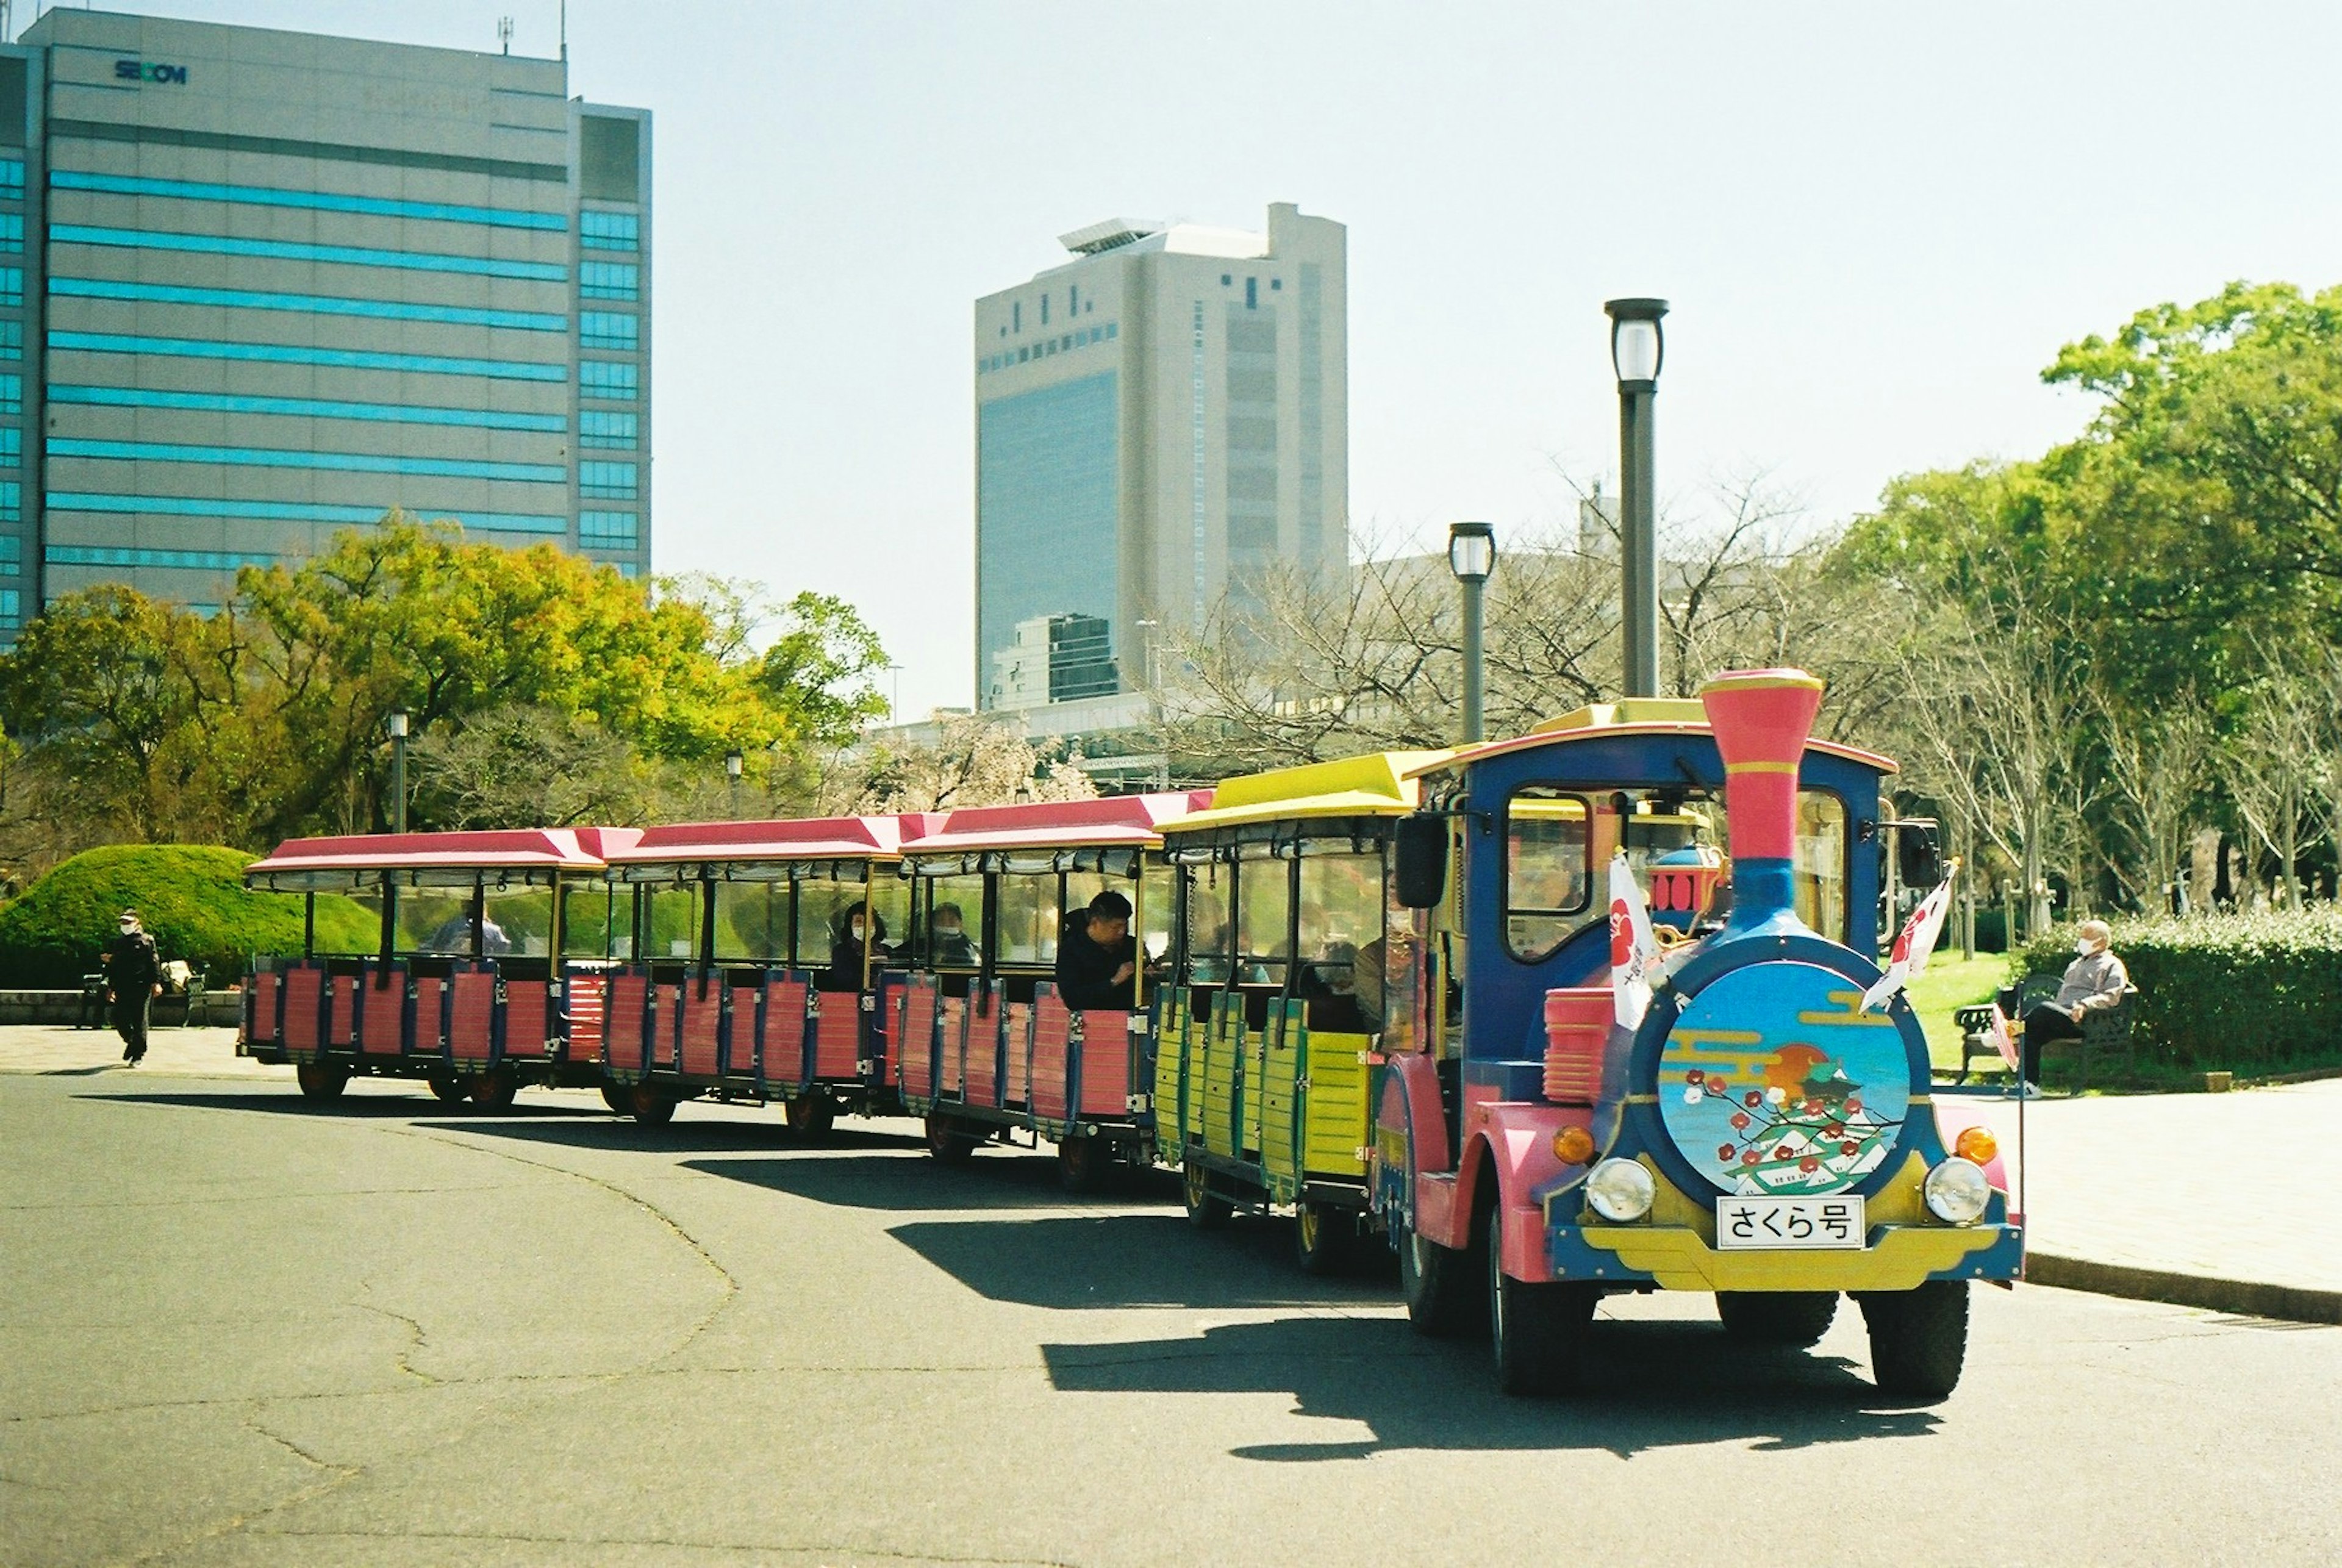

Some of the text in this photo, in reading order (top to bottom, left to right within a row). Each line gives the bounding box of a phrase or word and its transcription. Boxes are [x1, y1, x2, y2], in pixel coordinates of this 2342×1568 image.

[115, 60, 186, 85] SECOM
[1730, 1205, 1852, 1239] さくら号
